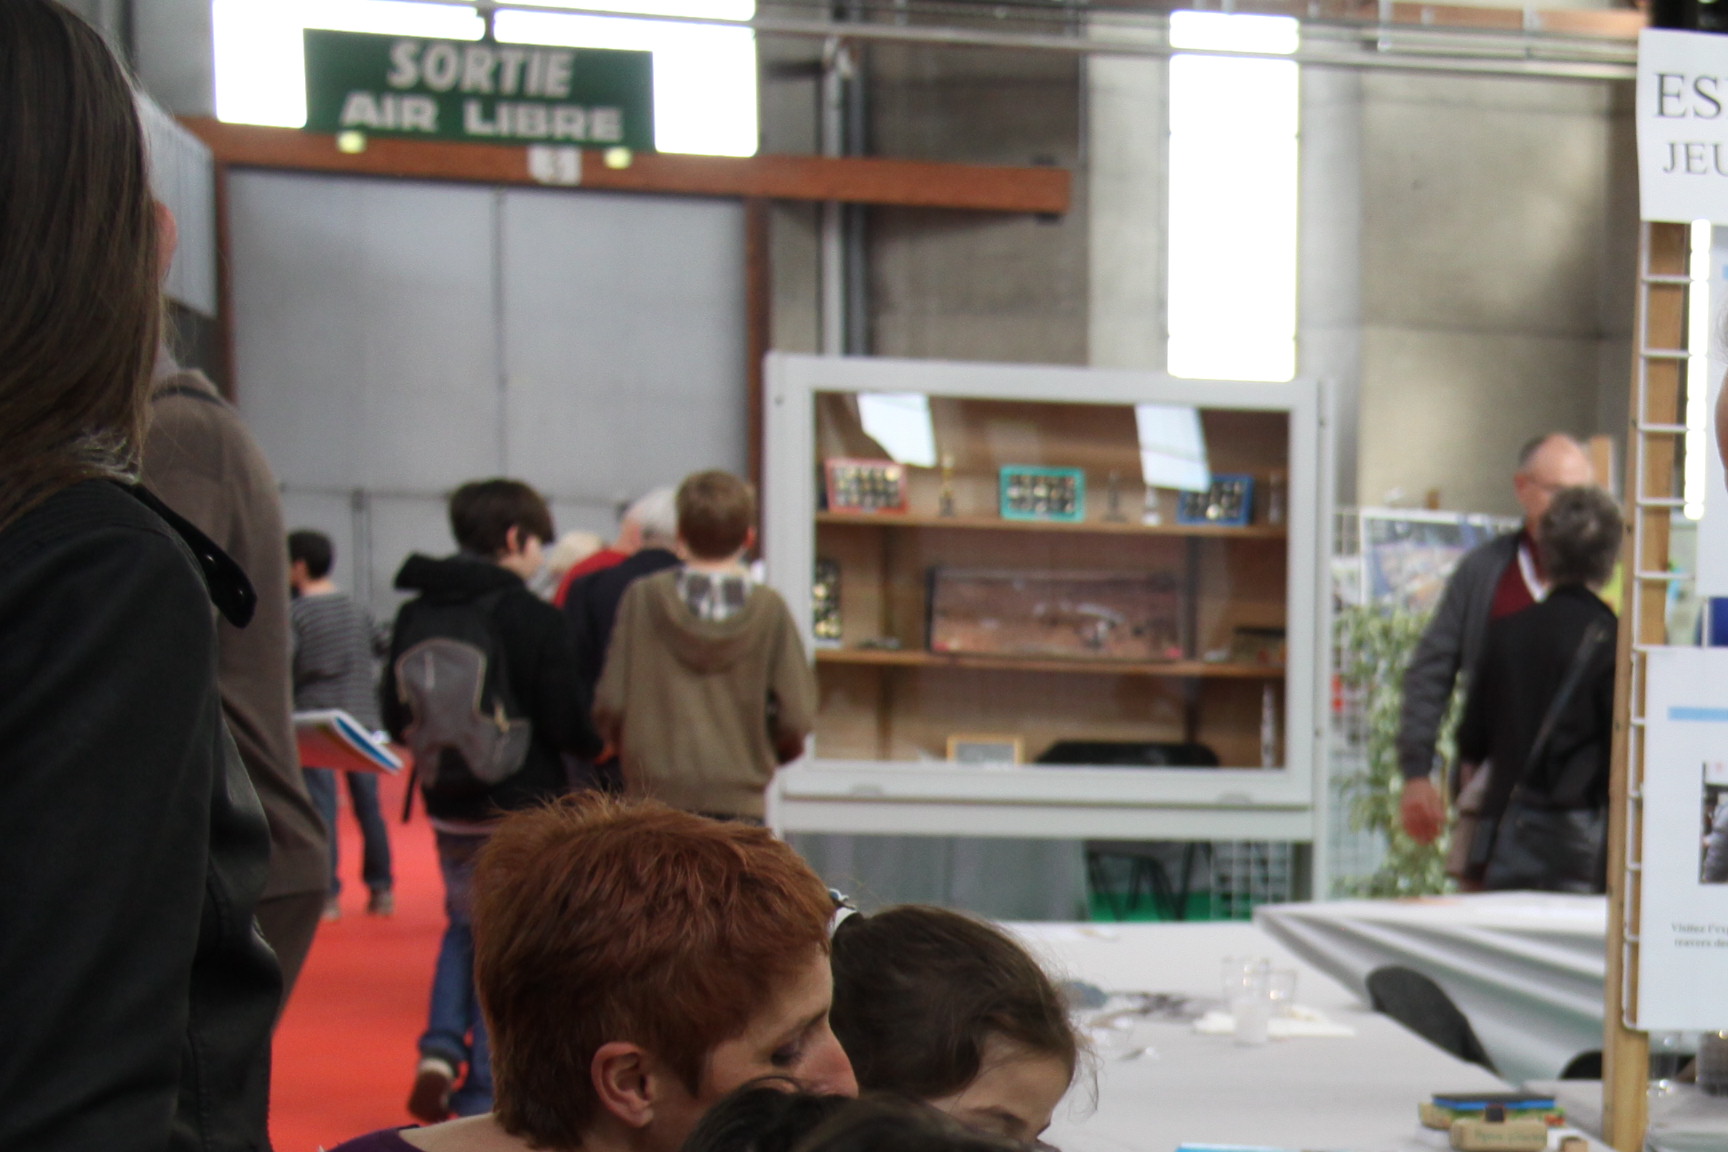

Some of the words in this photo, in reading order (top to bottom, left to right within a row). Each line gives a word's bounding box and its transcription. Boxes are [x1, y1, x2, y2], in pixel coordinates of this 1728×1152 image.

[386, 40, 576, 97] SORTIE
[339, 91, 438, 132] AIR
[464, 99, 623, 141] LIBRE
